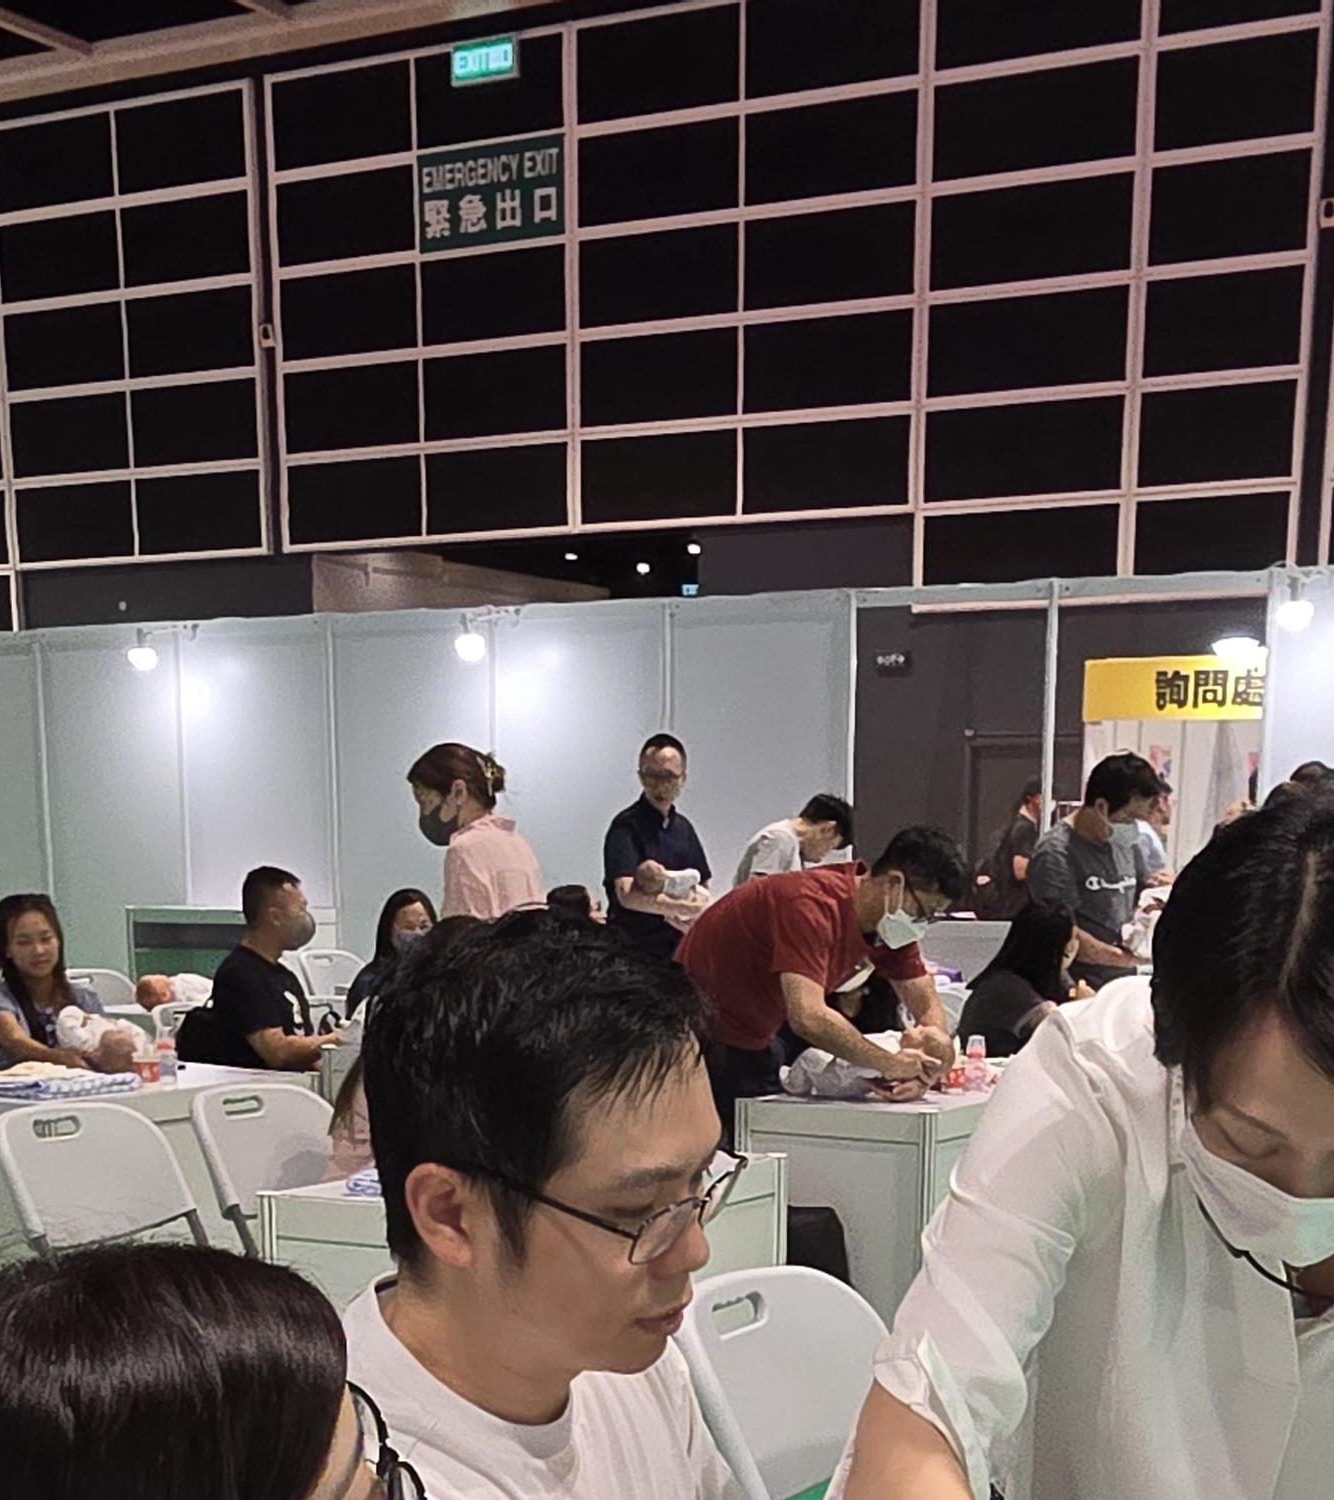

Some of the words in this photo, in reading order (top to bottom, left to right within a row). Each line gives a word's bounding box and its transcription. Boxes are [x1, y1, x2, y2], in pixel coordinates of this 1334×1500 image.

[422, 153, 520, 193] EMERGENCY
[523, 147, 560, 178] EXIT
[423, 186, 558, 239] 緊急出口
[1155, 667, 1267, 711] 詢問處
